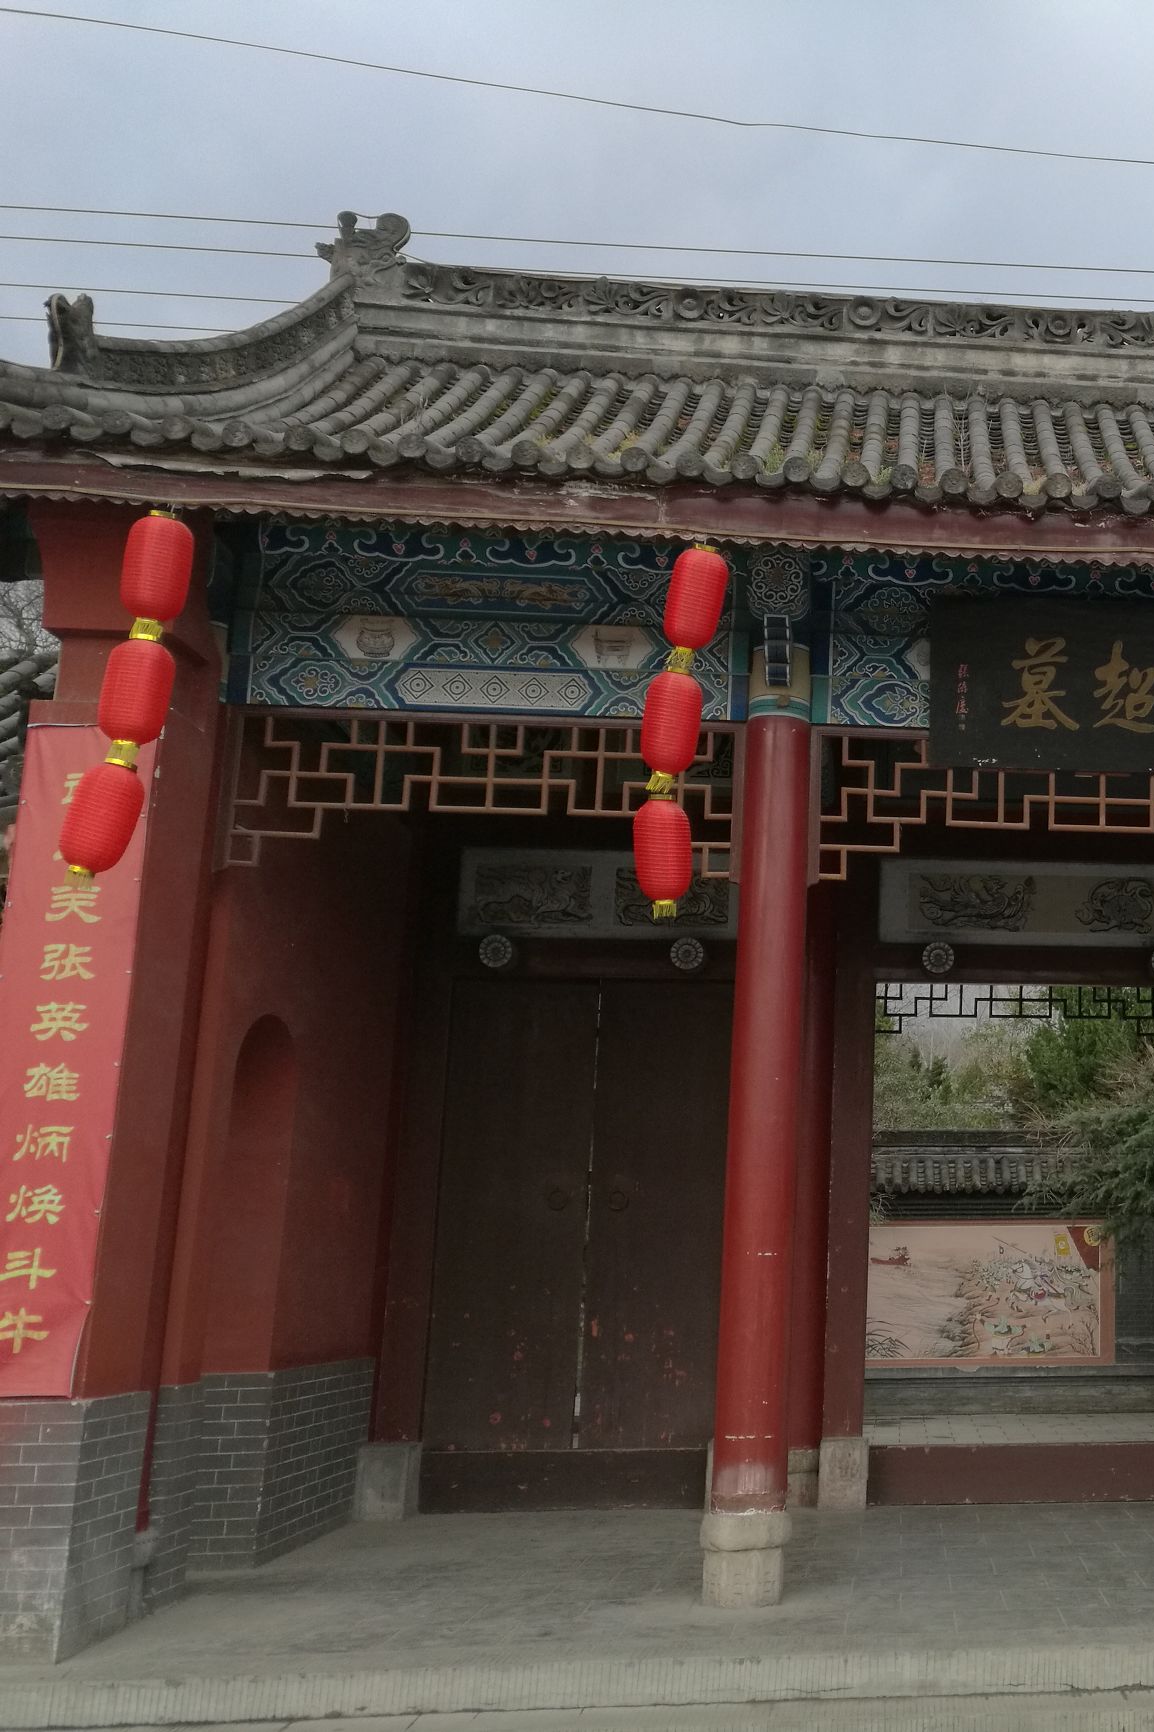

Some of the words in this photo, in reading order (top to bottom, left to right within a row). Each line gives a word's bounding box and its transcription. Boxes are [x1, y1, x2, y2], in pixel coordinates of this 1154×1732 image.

[0, 771, 103, 1355] 关张英雄炳焕斗牛
